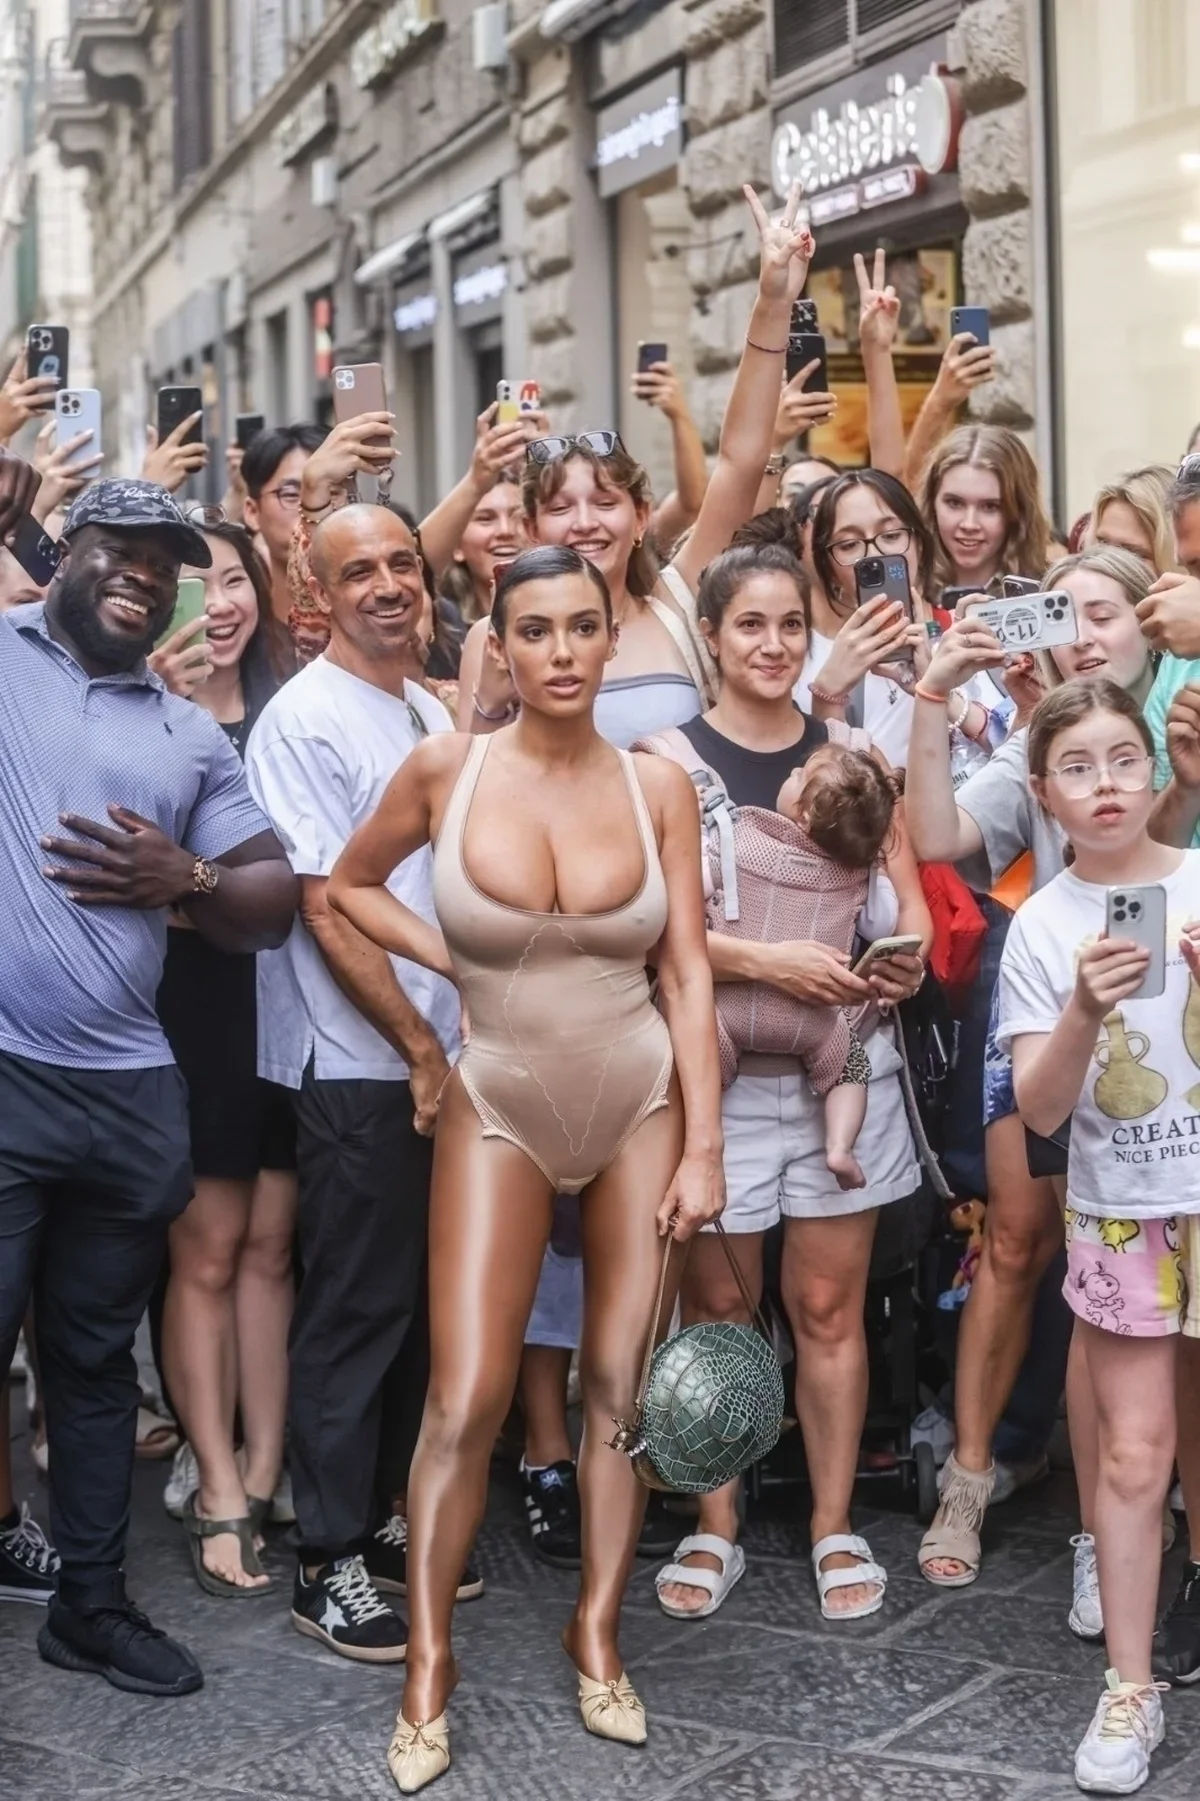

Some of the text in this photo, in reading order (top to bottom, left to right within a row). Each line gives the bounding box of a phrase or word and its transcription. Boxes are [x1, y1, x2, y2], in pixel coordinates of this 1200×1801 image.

[1112, 1114, 1200, 1145] CREAT
[1114, 1141, 1200, 1163] NICE PIEC
